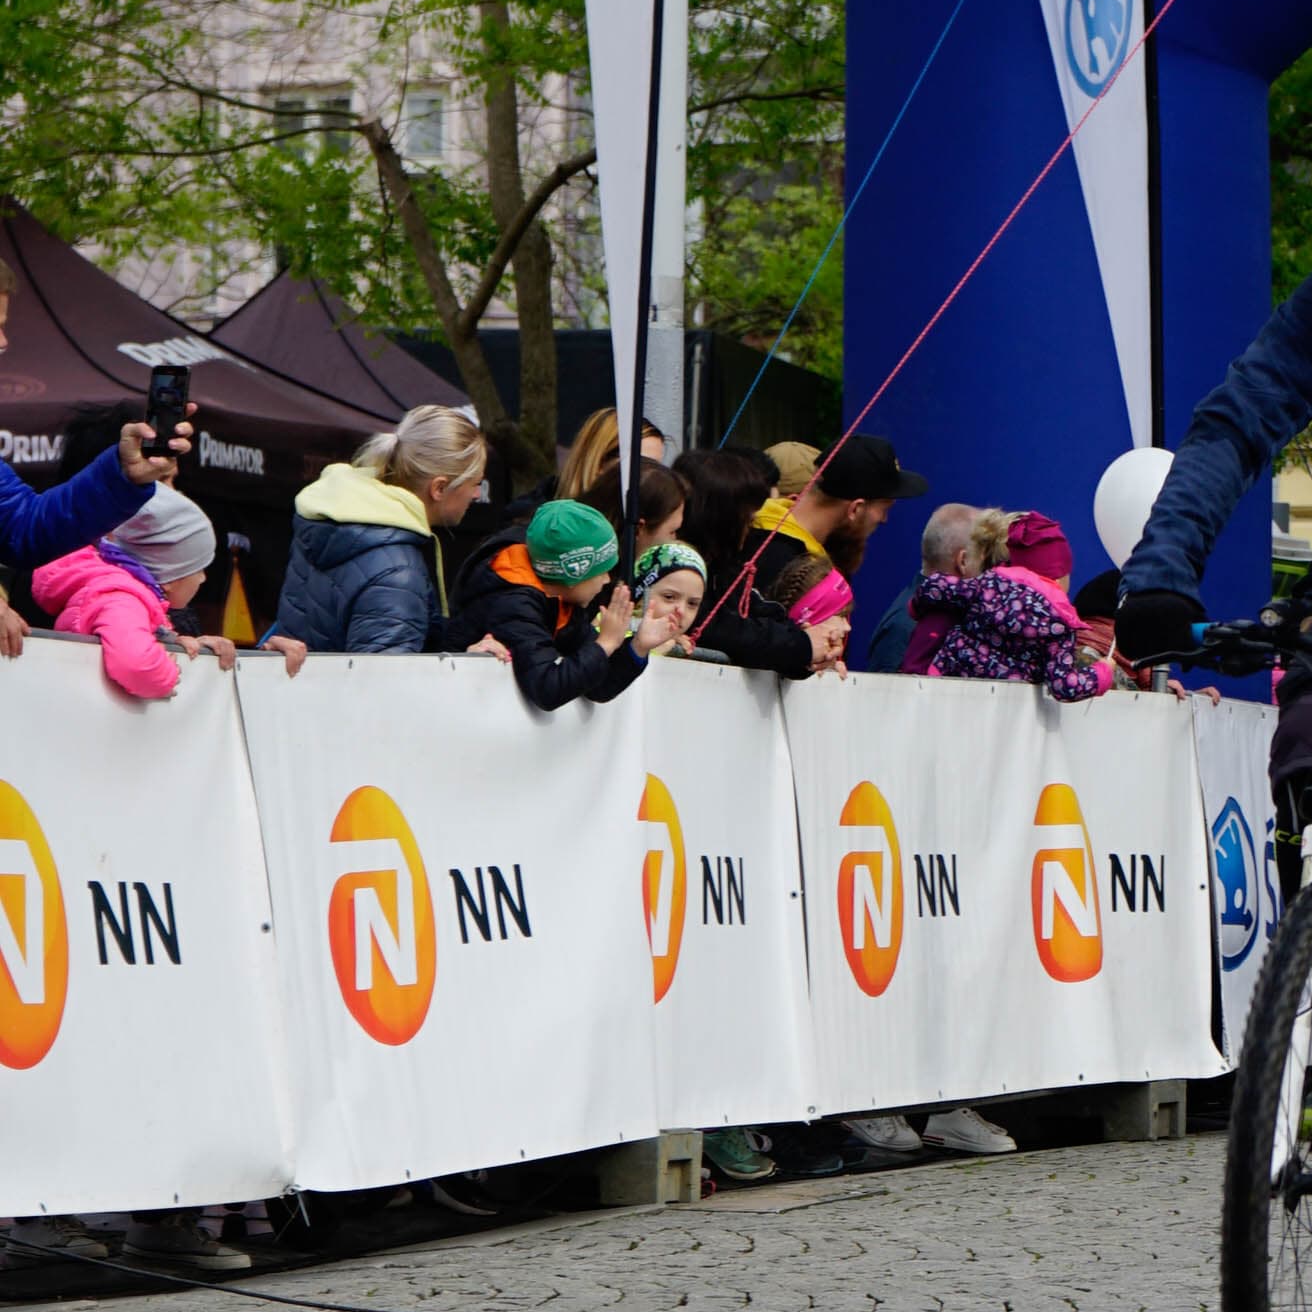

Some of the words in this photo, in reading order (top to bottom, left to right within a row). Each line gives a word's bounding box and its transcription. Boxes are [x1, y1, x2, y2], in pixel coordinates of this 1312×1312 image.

[199, 431, 265, 475] PRIMATOR
[449, 864, 532, 944] NN
[700, 855, 746, 925] NN
[914, 854, 960, 917] NN
[1109, 853, 1166, 913] NN
[87, 881, 181, 965] NN
